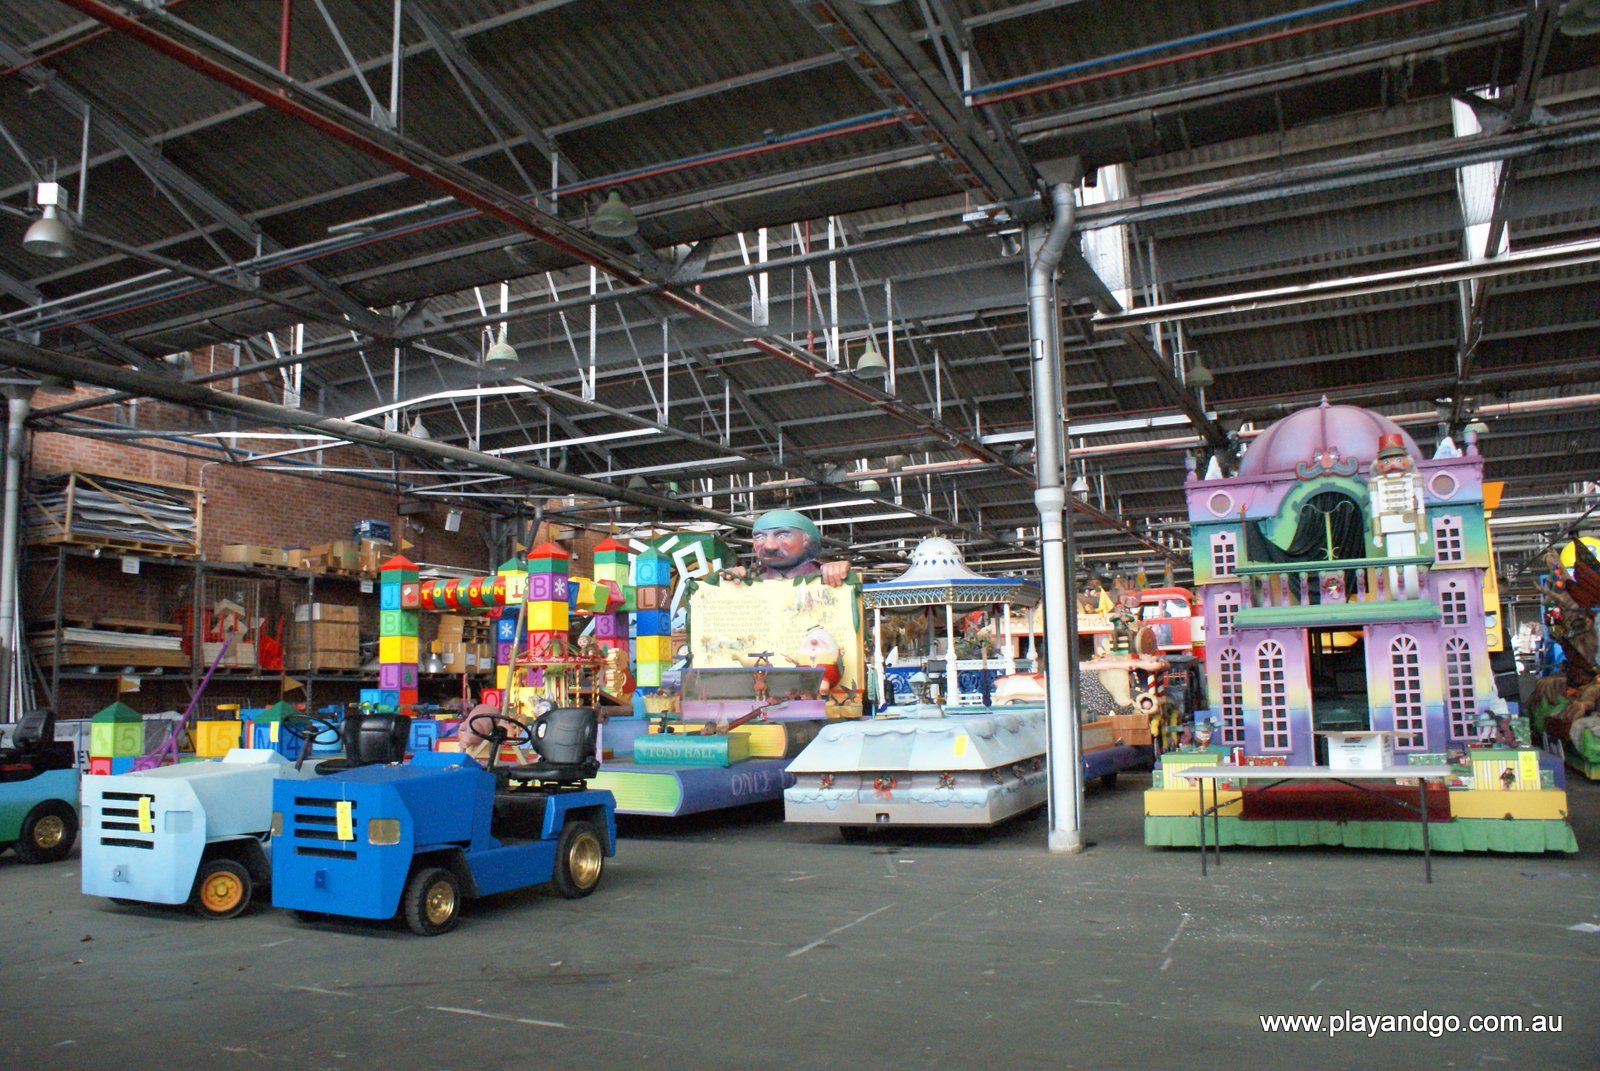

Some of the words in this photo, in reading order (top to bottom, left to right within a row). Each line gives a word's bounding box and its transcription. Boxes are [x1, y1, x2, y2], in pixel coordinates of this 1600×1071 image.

[385, 587, 394, 606] J
[421, 585, 504, 600] TOYTOWN
[533, 577, 546, 598] B
[643, 589, 653, 607] L
[384, 613, 396, 634] B
[600, 616, 610, 638] 3
[385, 665, 395, 686] L
[121, 727, 135, 752] 5
[216, 726, 232, 752] 5
[414, 724, 432, 747] E
[684, 747, 715, 759] HALL
[731, 770, 771, 796] ONCE
